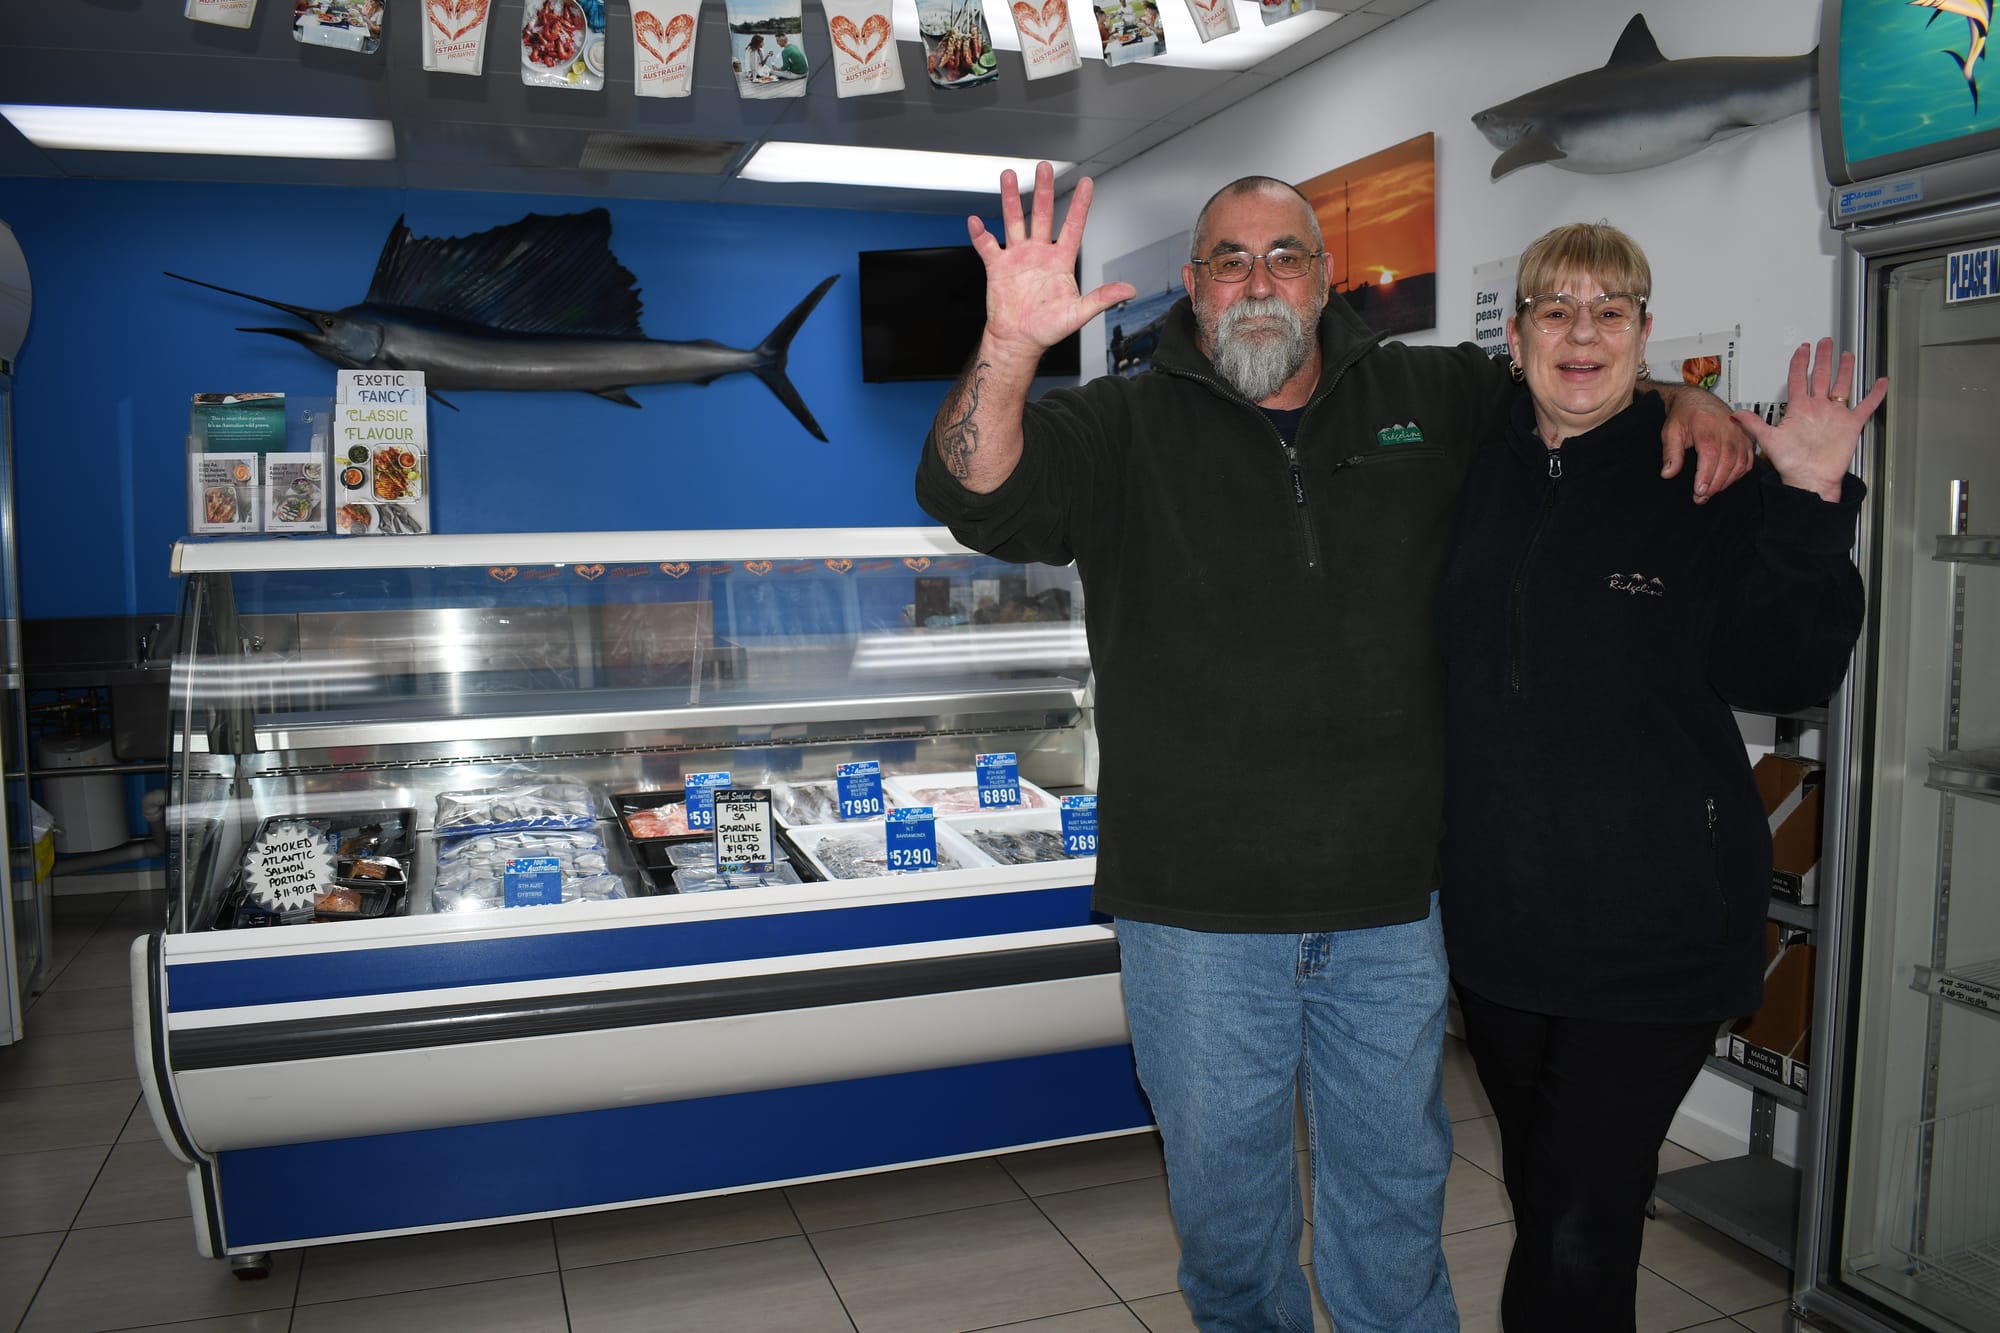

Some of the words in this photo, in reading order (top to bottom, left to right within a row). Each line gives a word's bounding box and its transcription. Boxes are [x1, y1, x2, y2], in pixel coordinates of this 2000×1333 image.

[1032, 40, 1070, 64] AUSTRALIAN
[1950, 251, 1988, 300] PLEASE
[1476, 292, 1499, 305] Easy
[1476, 308, 1503, 325] peasy
[1476, 327, 1503, 341] lemon
[353, 375, 405, 386] EXOTIC
[358, 389, 410, 403] FANCY
[346, 409, 408, 422] CLASSIC
[345, 427, 414, 440] FLAVOUR
[1610, 579, 1664, 598] Ridgeline
[726, 804, 757, 812] FRESH
[733, 813, 746, 821] SA
[719, 823, 762, 833] SARDINE
[723, 834, 760, 843] FILLETS
[262, 838, 312, 855] SMOKED
[261, 851, 315, 867] ATLANTIC
[264, 862, 304, 877] SALMON
[528, 864, 558, 873] Australian
[269, 870, 315, 888] PORTIONS
[1751, 1050, 1768, 1063] MADE
[1769, 1057, 1777, 1066] IN
[1747, 1058, 1779, 1076] AUSTRALIA
